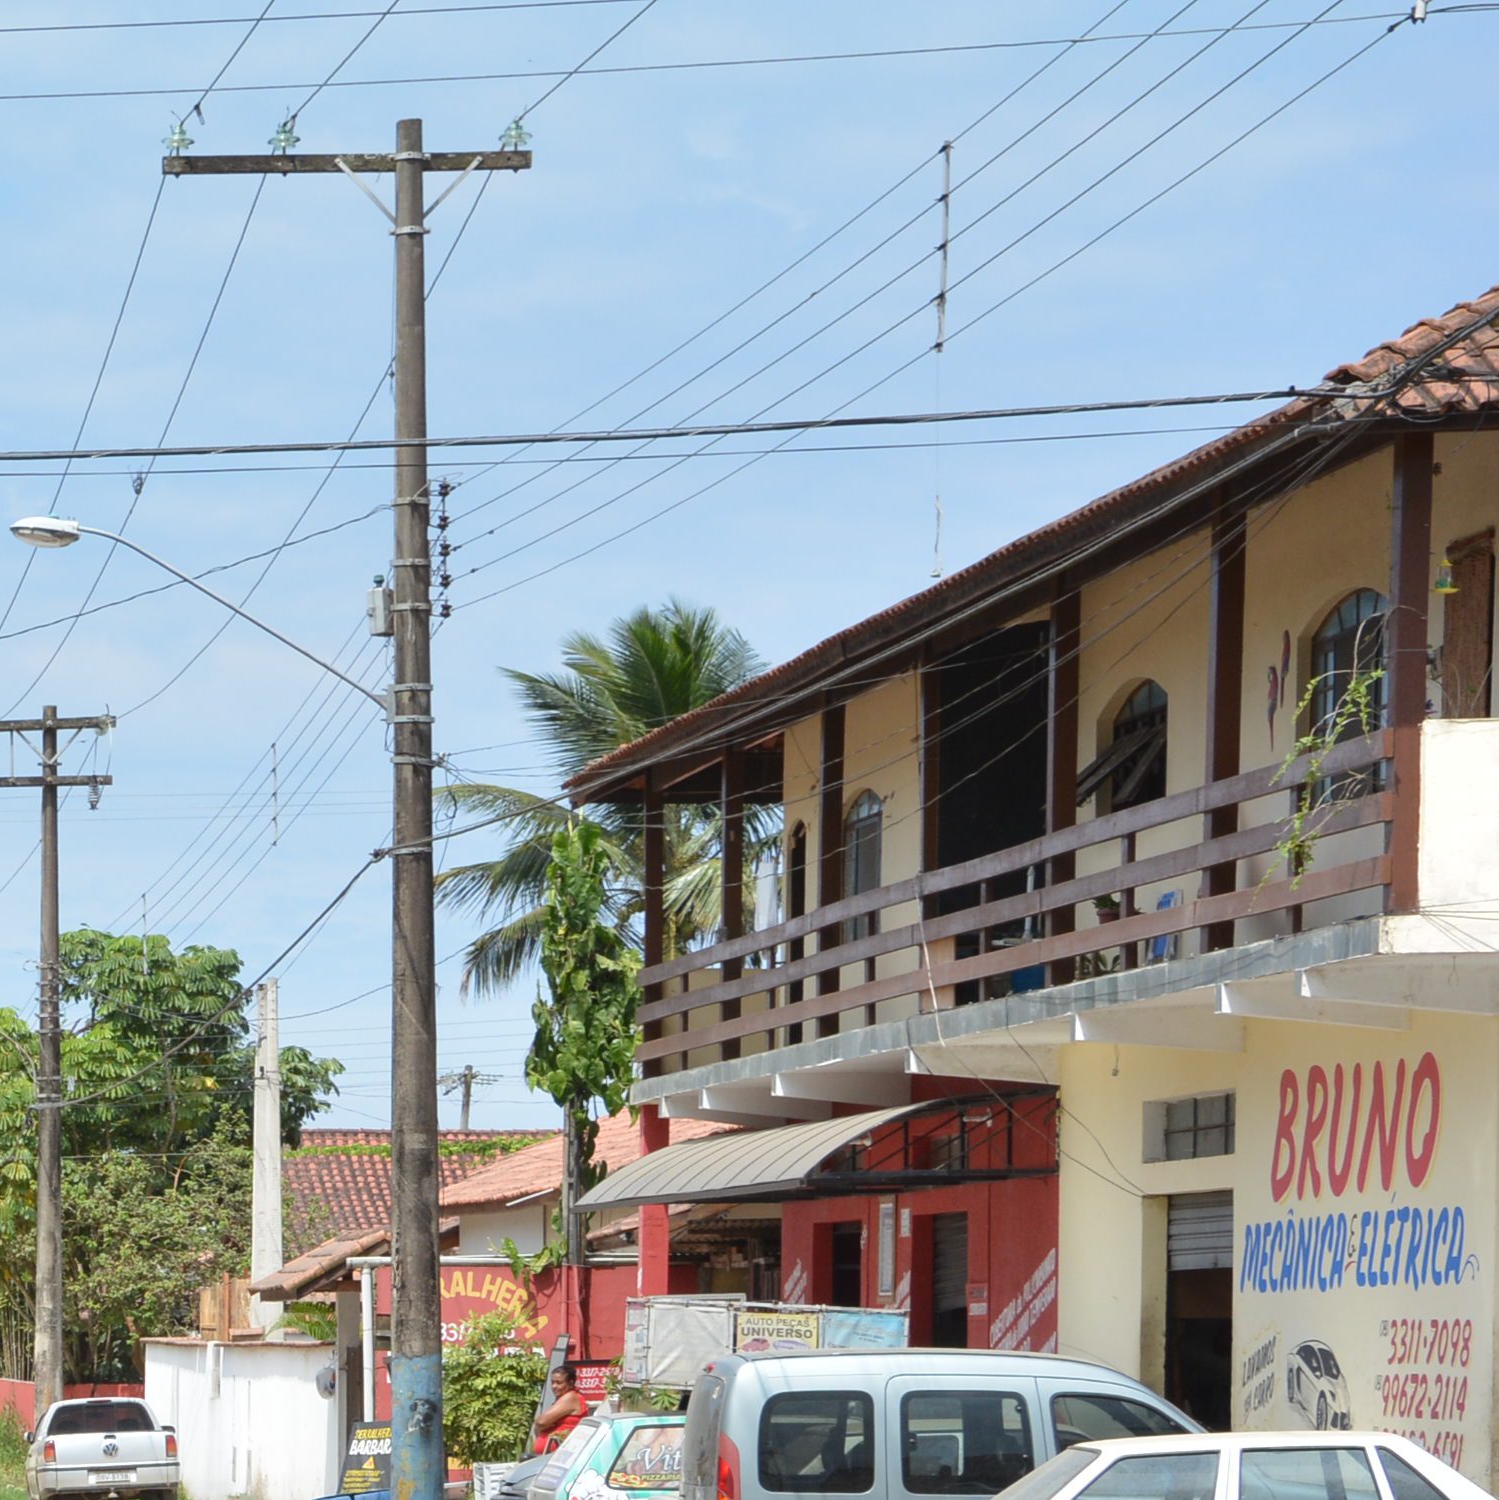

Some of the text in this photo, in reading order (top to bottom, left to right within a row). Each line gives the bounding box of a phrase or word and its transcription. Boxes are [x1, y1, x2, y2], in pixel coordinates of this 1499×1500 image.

[1270, 1052, 1441, 1202] BRUNO
[745, 1317, 774, 1327] AUTO
[741, 1327, 814, 1339] UNIVERSO
